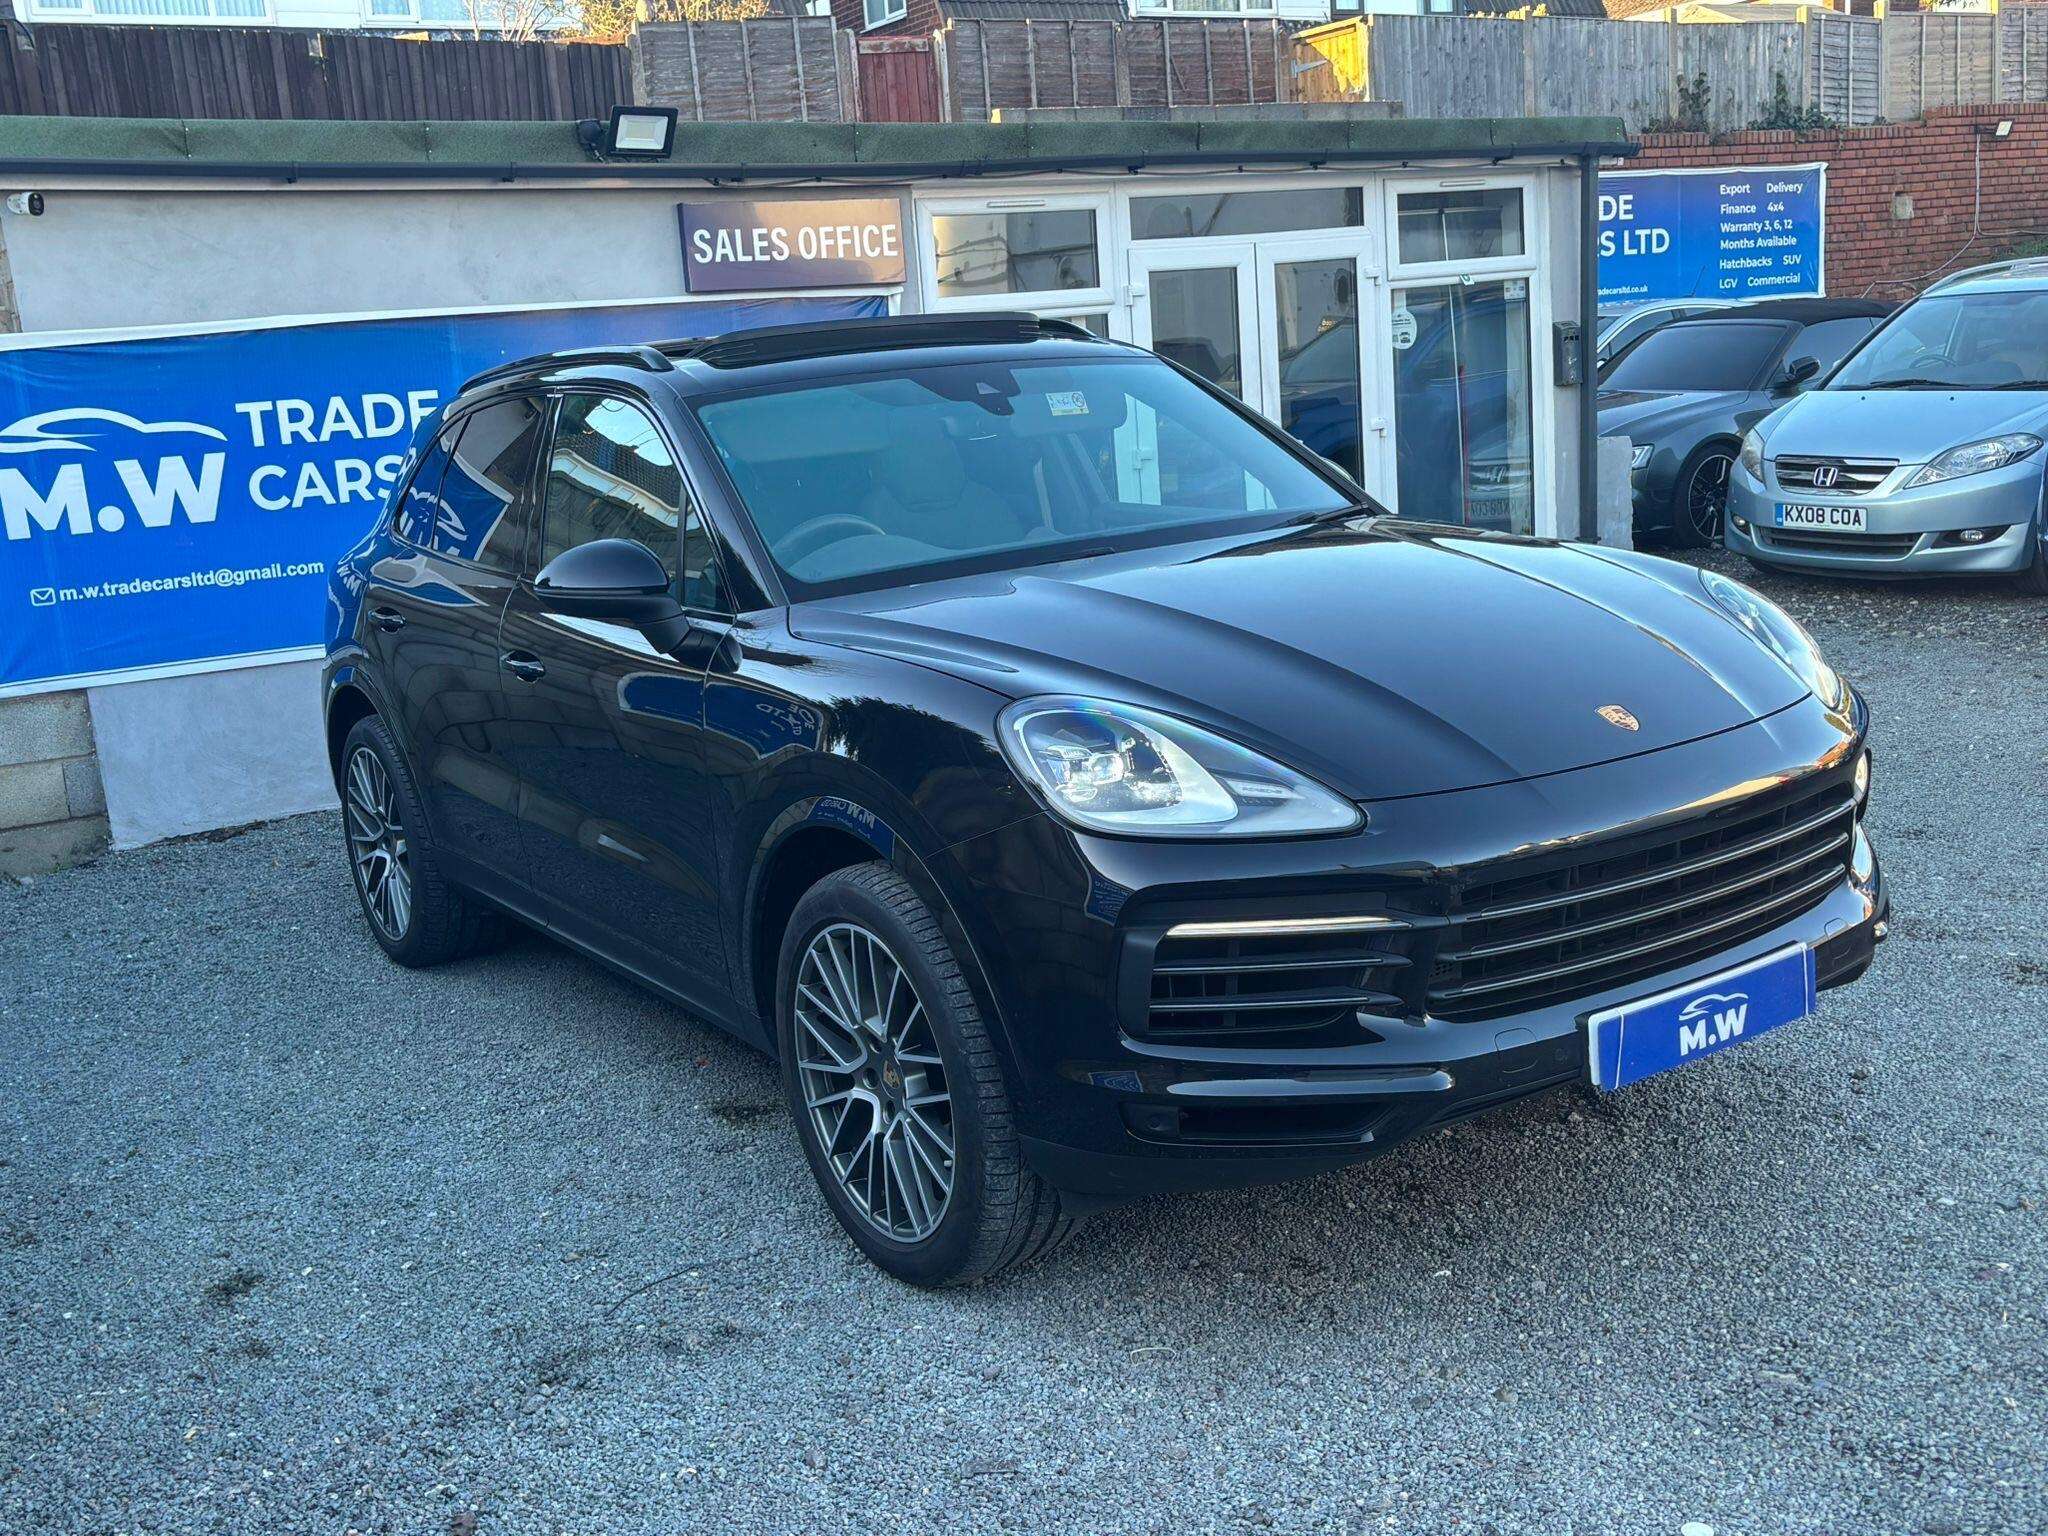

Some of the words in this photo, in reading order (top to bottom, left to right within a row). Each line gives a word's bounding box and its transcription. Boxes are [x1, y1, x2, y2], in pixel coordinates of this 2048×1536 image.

[1719, 183, 1750, 196] Export
[1766, 181, 1803, 195] Delivery
[1720, 204, 1757, 215] Finance
[1767, 202, 1785, 213] 4x4
[1720, 221, 1763, 234] Warranty
[1783, 219, 1793, 230] 12
[693, 227, 790, 264] SALES
[797, 224, 898, 260] OFFICE
[1623, 228, 1670, 255] LTD
[1720, 237, 1755, 250] Months
[1756, 235, 1797, 248] Available
[1719, 256, 1773, 270] Hatchbacks
[1783, 254, 1802, 266] SUV
[1719, 278, 1738, 289] LGV
[1747, 273, 1801, 287] Commercial
[0, 451, 226, 541] M.W
[1785, 505, 1825, 524] KX08
[1830, 508, 1862, 526] COA
[59, 560, 325, 602] m.w.tradecarsltd@gmail.com
[1679, 1003, 1749, 1057] M.W
